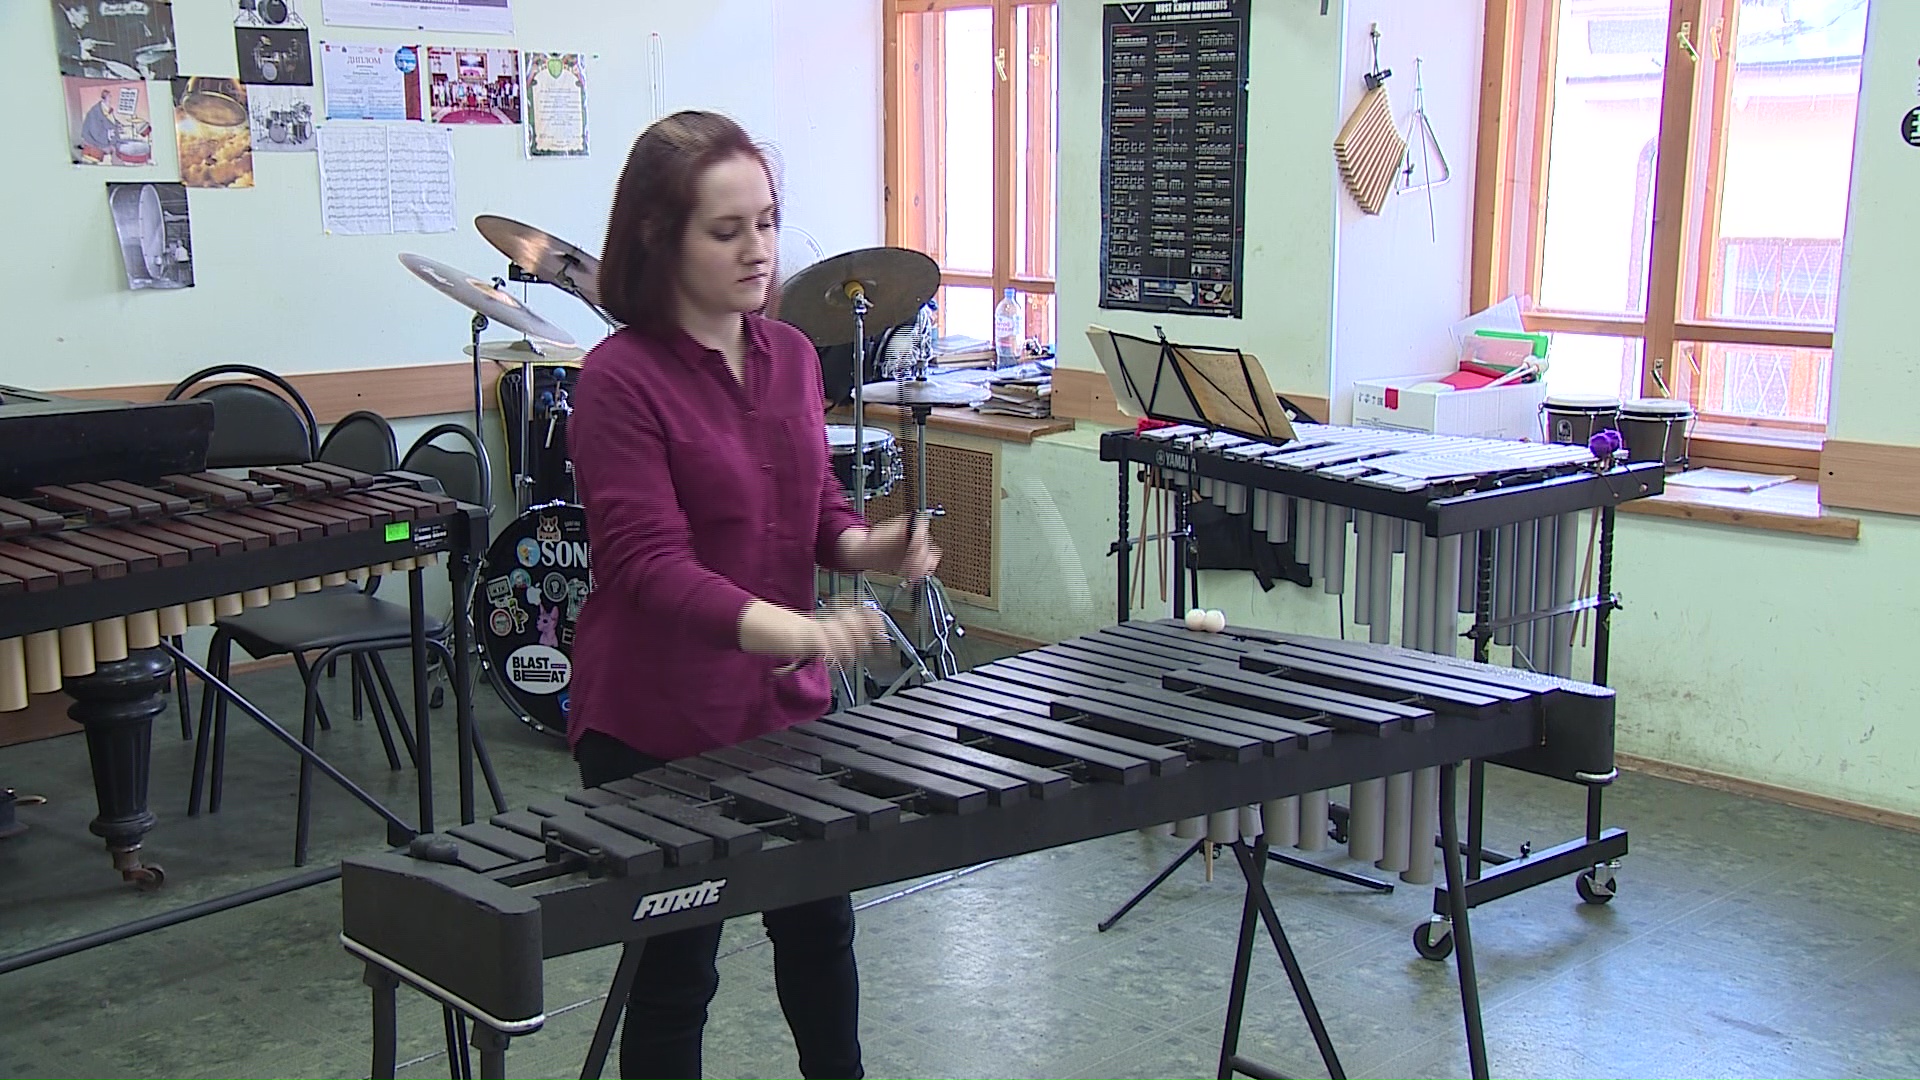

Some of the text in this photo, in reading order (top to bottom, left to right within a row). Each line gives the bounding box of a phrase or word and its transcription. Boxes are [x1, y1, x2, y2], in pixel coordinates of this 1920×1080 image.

[347, 56, 381, 65] ДИПЛОМ
[541, 540, 591, 568] SON
[512, 656, 550, 669] BLAST
[513, 669, 566, 683] BEAT
[632, 879, 727, 921] FORTE
